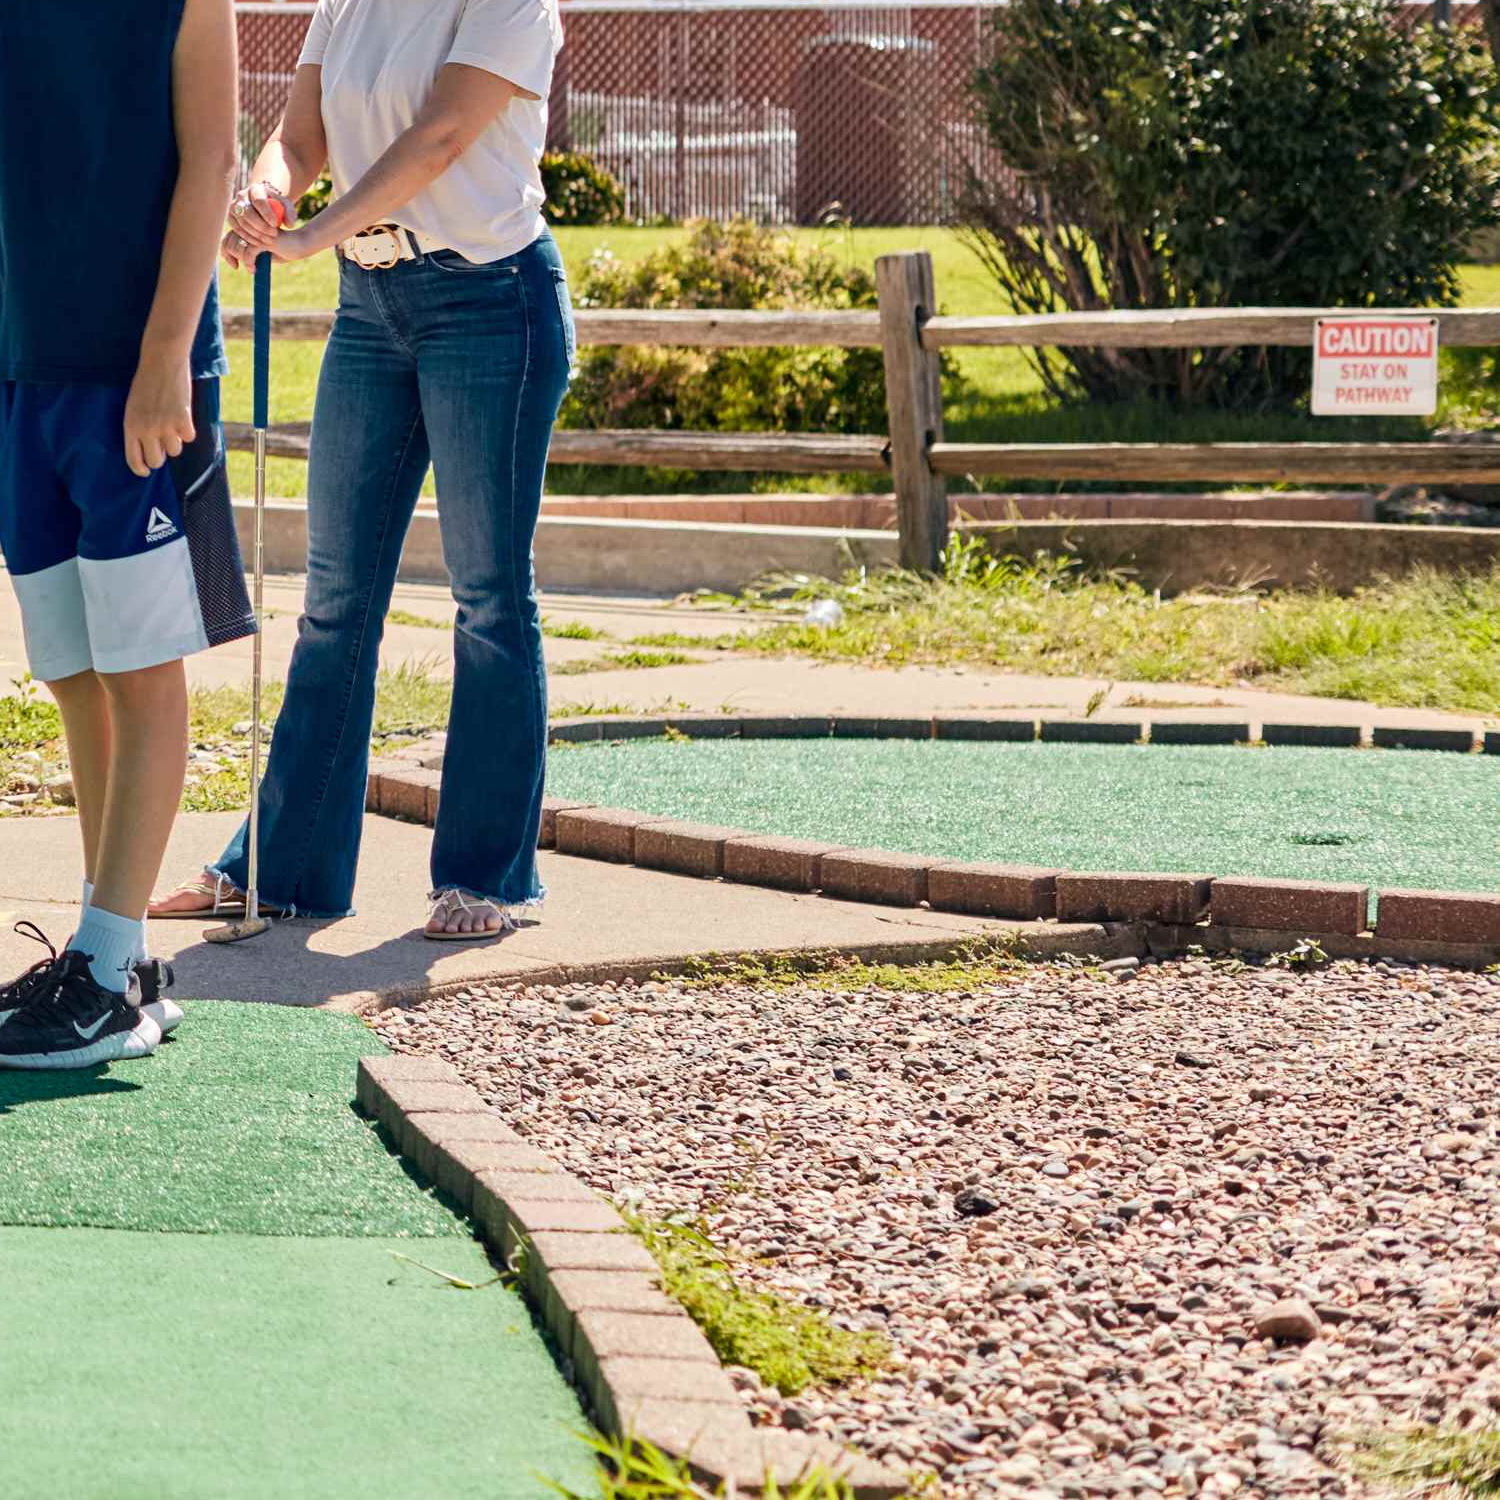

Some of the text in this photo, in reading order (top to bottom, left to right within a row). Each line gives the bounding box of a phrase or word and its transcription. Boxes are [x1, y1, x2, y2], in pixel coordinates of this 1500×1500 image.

[1323, 327, 1429, 353] CAUTION
[1340, 364, 1408, 380] STAY ON
[1336, 388, 1413, 403] PATHWAY
[145, 526, 178, 543] Reebok
